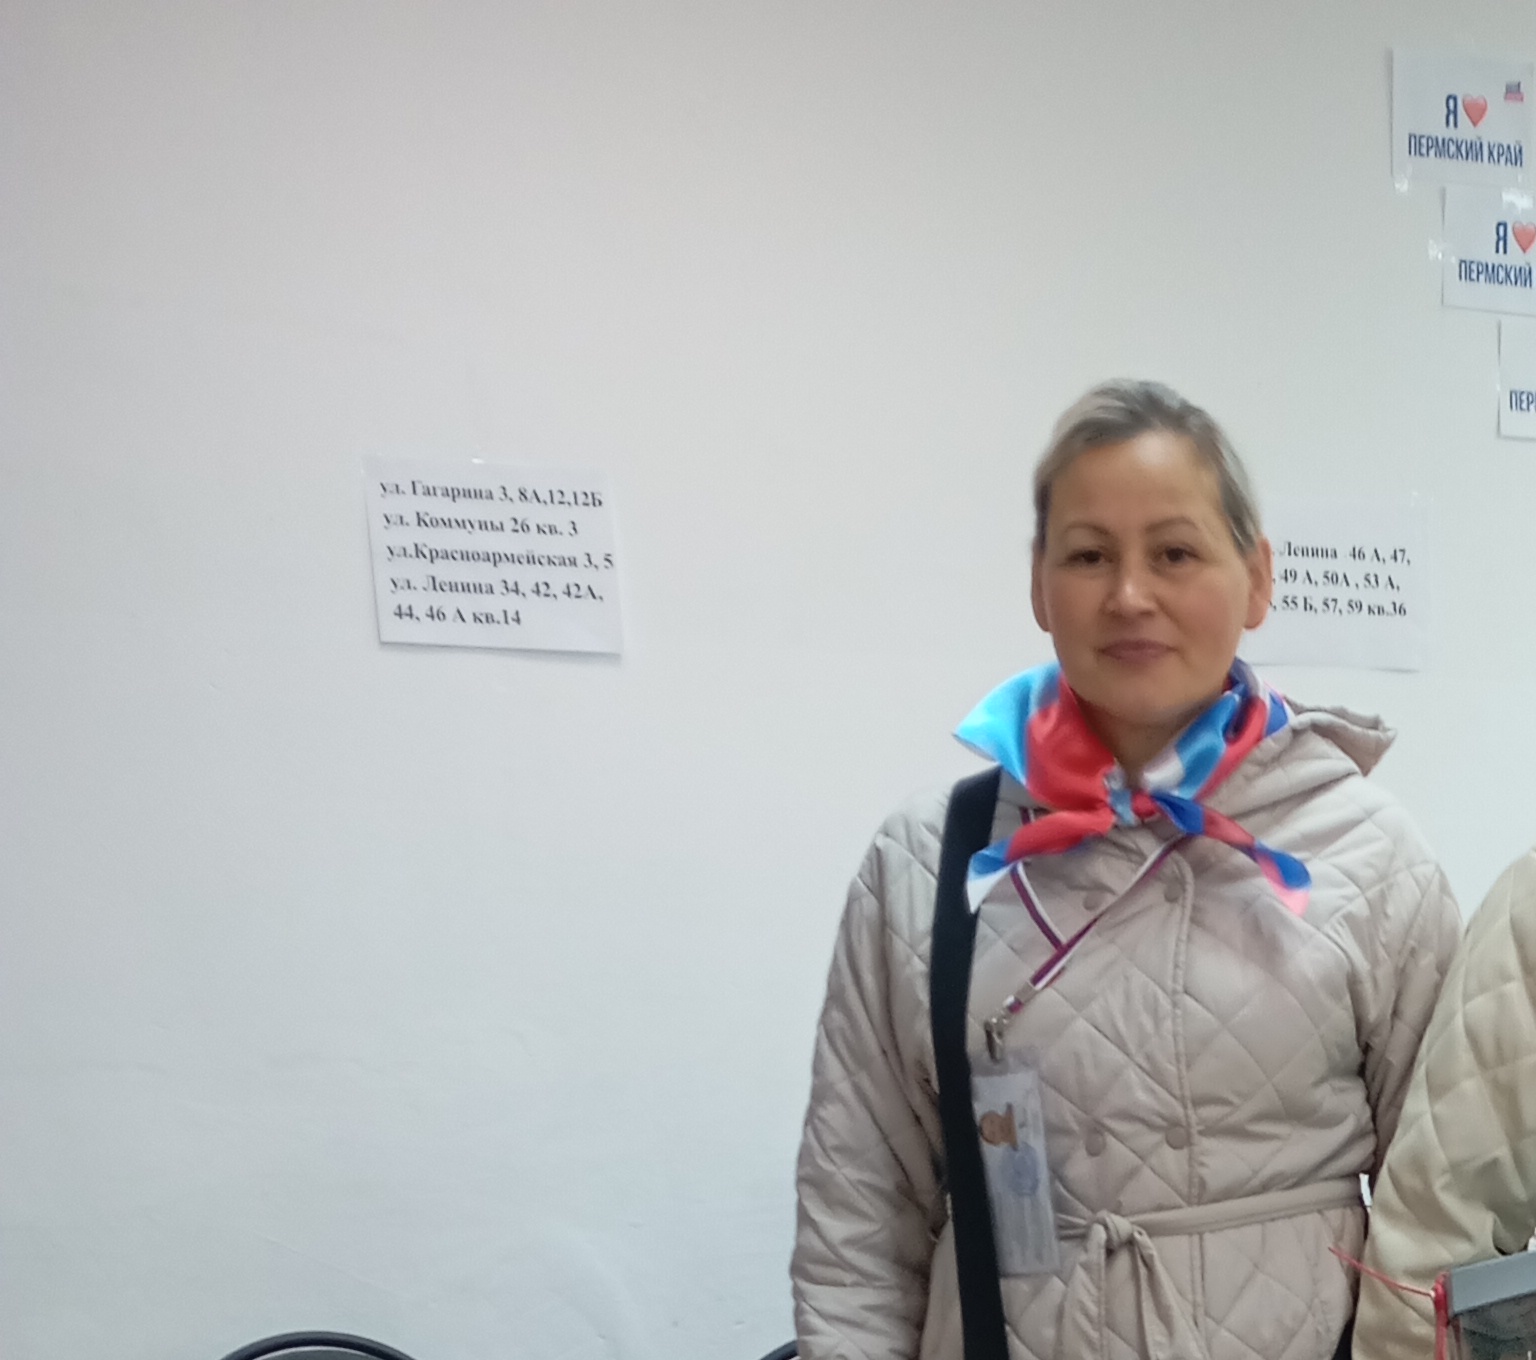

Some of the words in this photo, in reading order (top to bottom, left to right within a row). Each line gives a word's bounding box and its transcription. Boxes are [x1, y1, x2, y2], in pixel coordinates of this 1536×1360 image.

[1445, 94, 1458, 129] Я
[1408, 133, 1484, 163] ПЕРМСКИЙ
[1487, 140, 1523, 168] КРАЙ
[1495, 220, 1508, 255] Я
[1459, 259, 1532, 289] ПЕРМСКИЙ
[380, 481, 405, 498] ул.
[411, 480, 494, 503] Гагарина
[499, 486, 514, 502] 3,
[383, 513, 409, 529] ул.
[416, 512, 504, 534] Коммуны
[510, 517, 530, 533] 26
[536, 522, 563, 536] кв.
[568, 521, 578, 536] 3
[386, 543, 578, 568] ул.Красноармейская
[583, 553, 599, 570] 3,
[604, 553, 614, 569] 5
[1279, 541, 1337, 560] Ленина
[1349, 547, 1365, 561] 46
[1371, 548, 1386, 565] А,
[1390, 549, 1411, 565] 47,
[390, 577, 417, 594] ул.
[422, 575, 494, 595] Ленина
[500, 580, 526, 598] 34,
[531, 582, 557, 600] 42,
[562, 584, 603, 602] 42А,
[1280, 569, 1297, 584] 49
[1302, 570, 1318, 587] А,
[1364, 573, 1379, 589] 53
[1385, 575, 1400, 591] А,
[393, 604, 420, 622] 44,
[425, 605, 446, 622] 46
[452, 608, 466, 623] А
[472, 610, 521, 625] кв.14
[1282, 596, 1298, 611] 55
[1303, 597, 1318, 613] Б,
[1322, 598, 1343, 615] 57,
[1347, 599, 1363, 615] 59
[1368, 602, 1407, 617] кв.36
